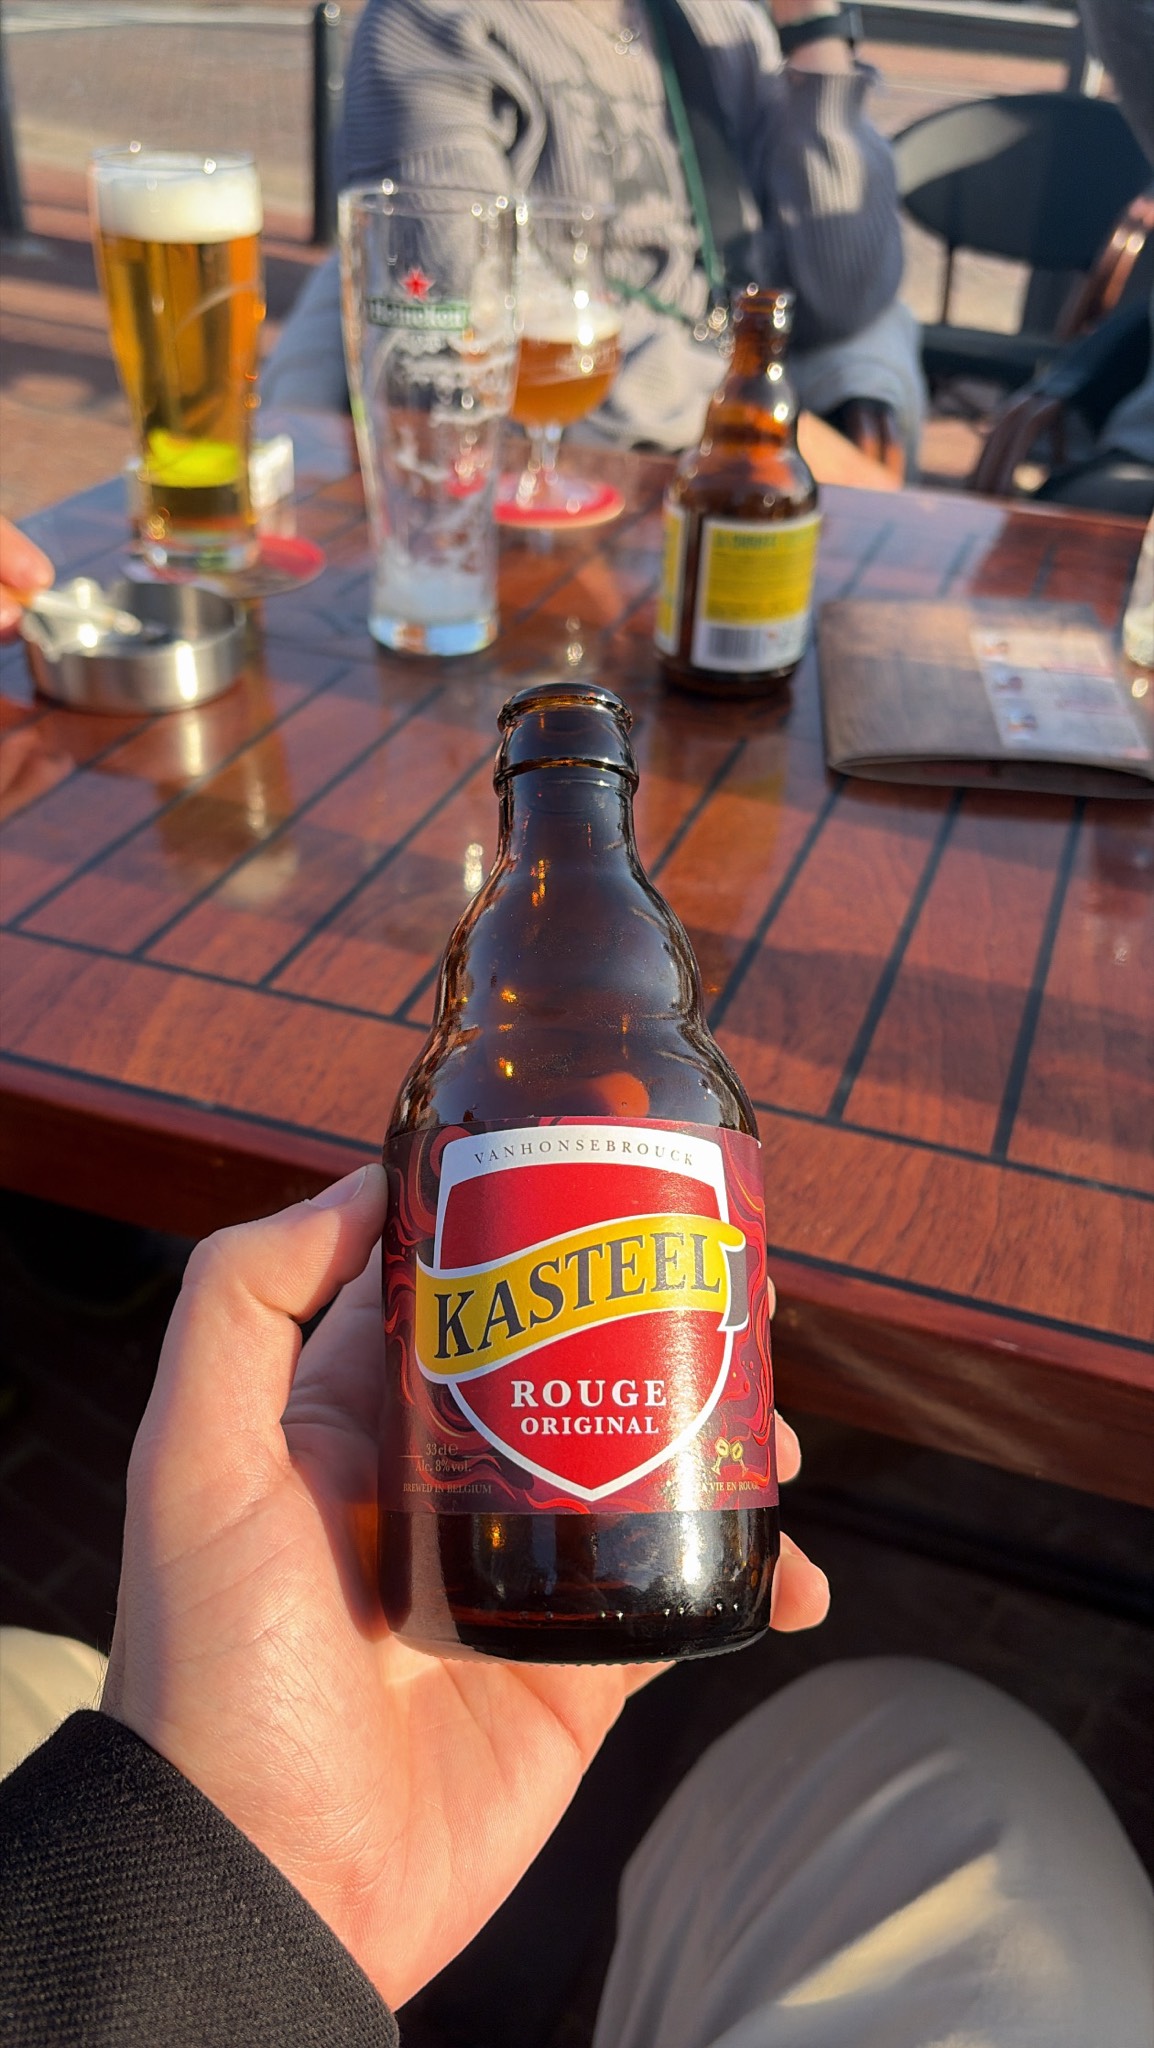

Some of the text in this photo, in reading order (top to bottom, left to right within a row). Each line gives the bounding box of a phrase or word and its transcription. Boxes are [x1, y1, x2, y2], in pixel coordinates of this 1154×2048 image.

[474, 1139, 694, 1166] VANHONSEBROUCK
[434, 1232, 721, 1359] KASTEEL
[511, 1379, 668, 1408] ROUGE
[520, 1416, 660, 1435] ORIGINAL
[403, 1483, 492, 1495] BREWED IN BELGIUM
[726, 1482, 737, 1491] EN
